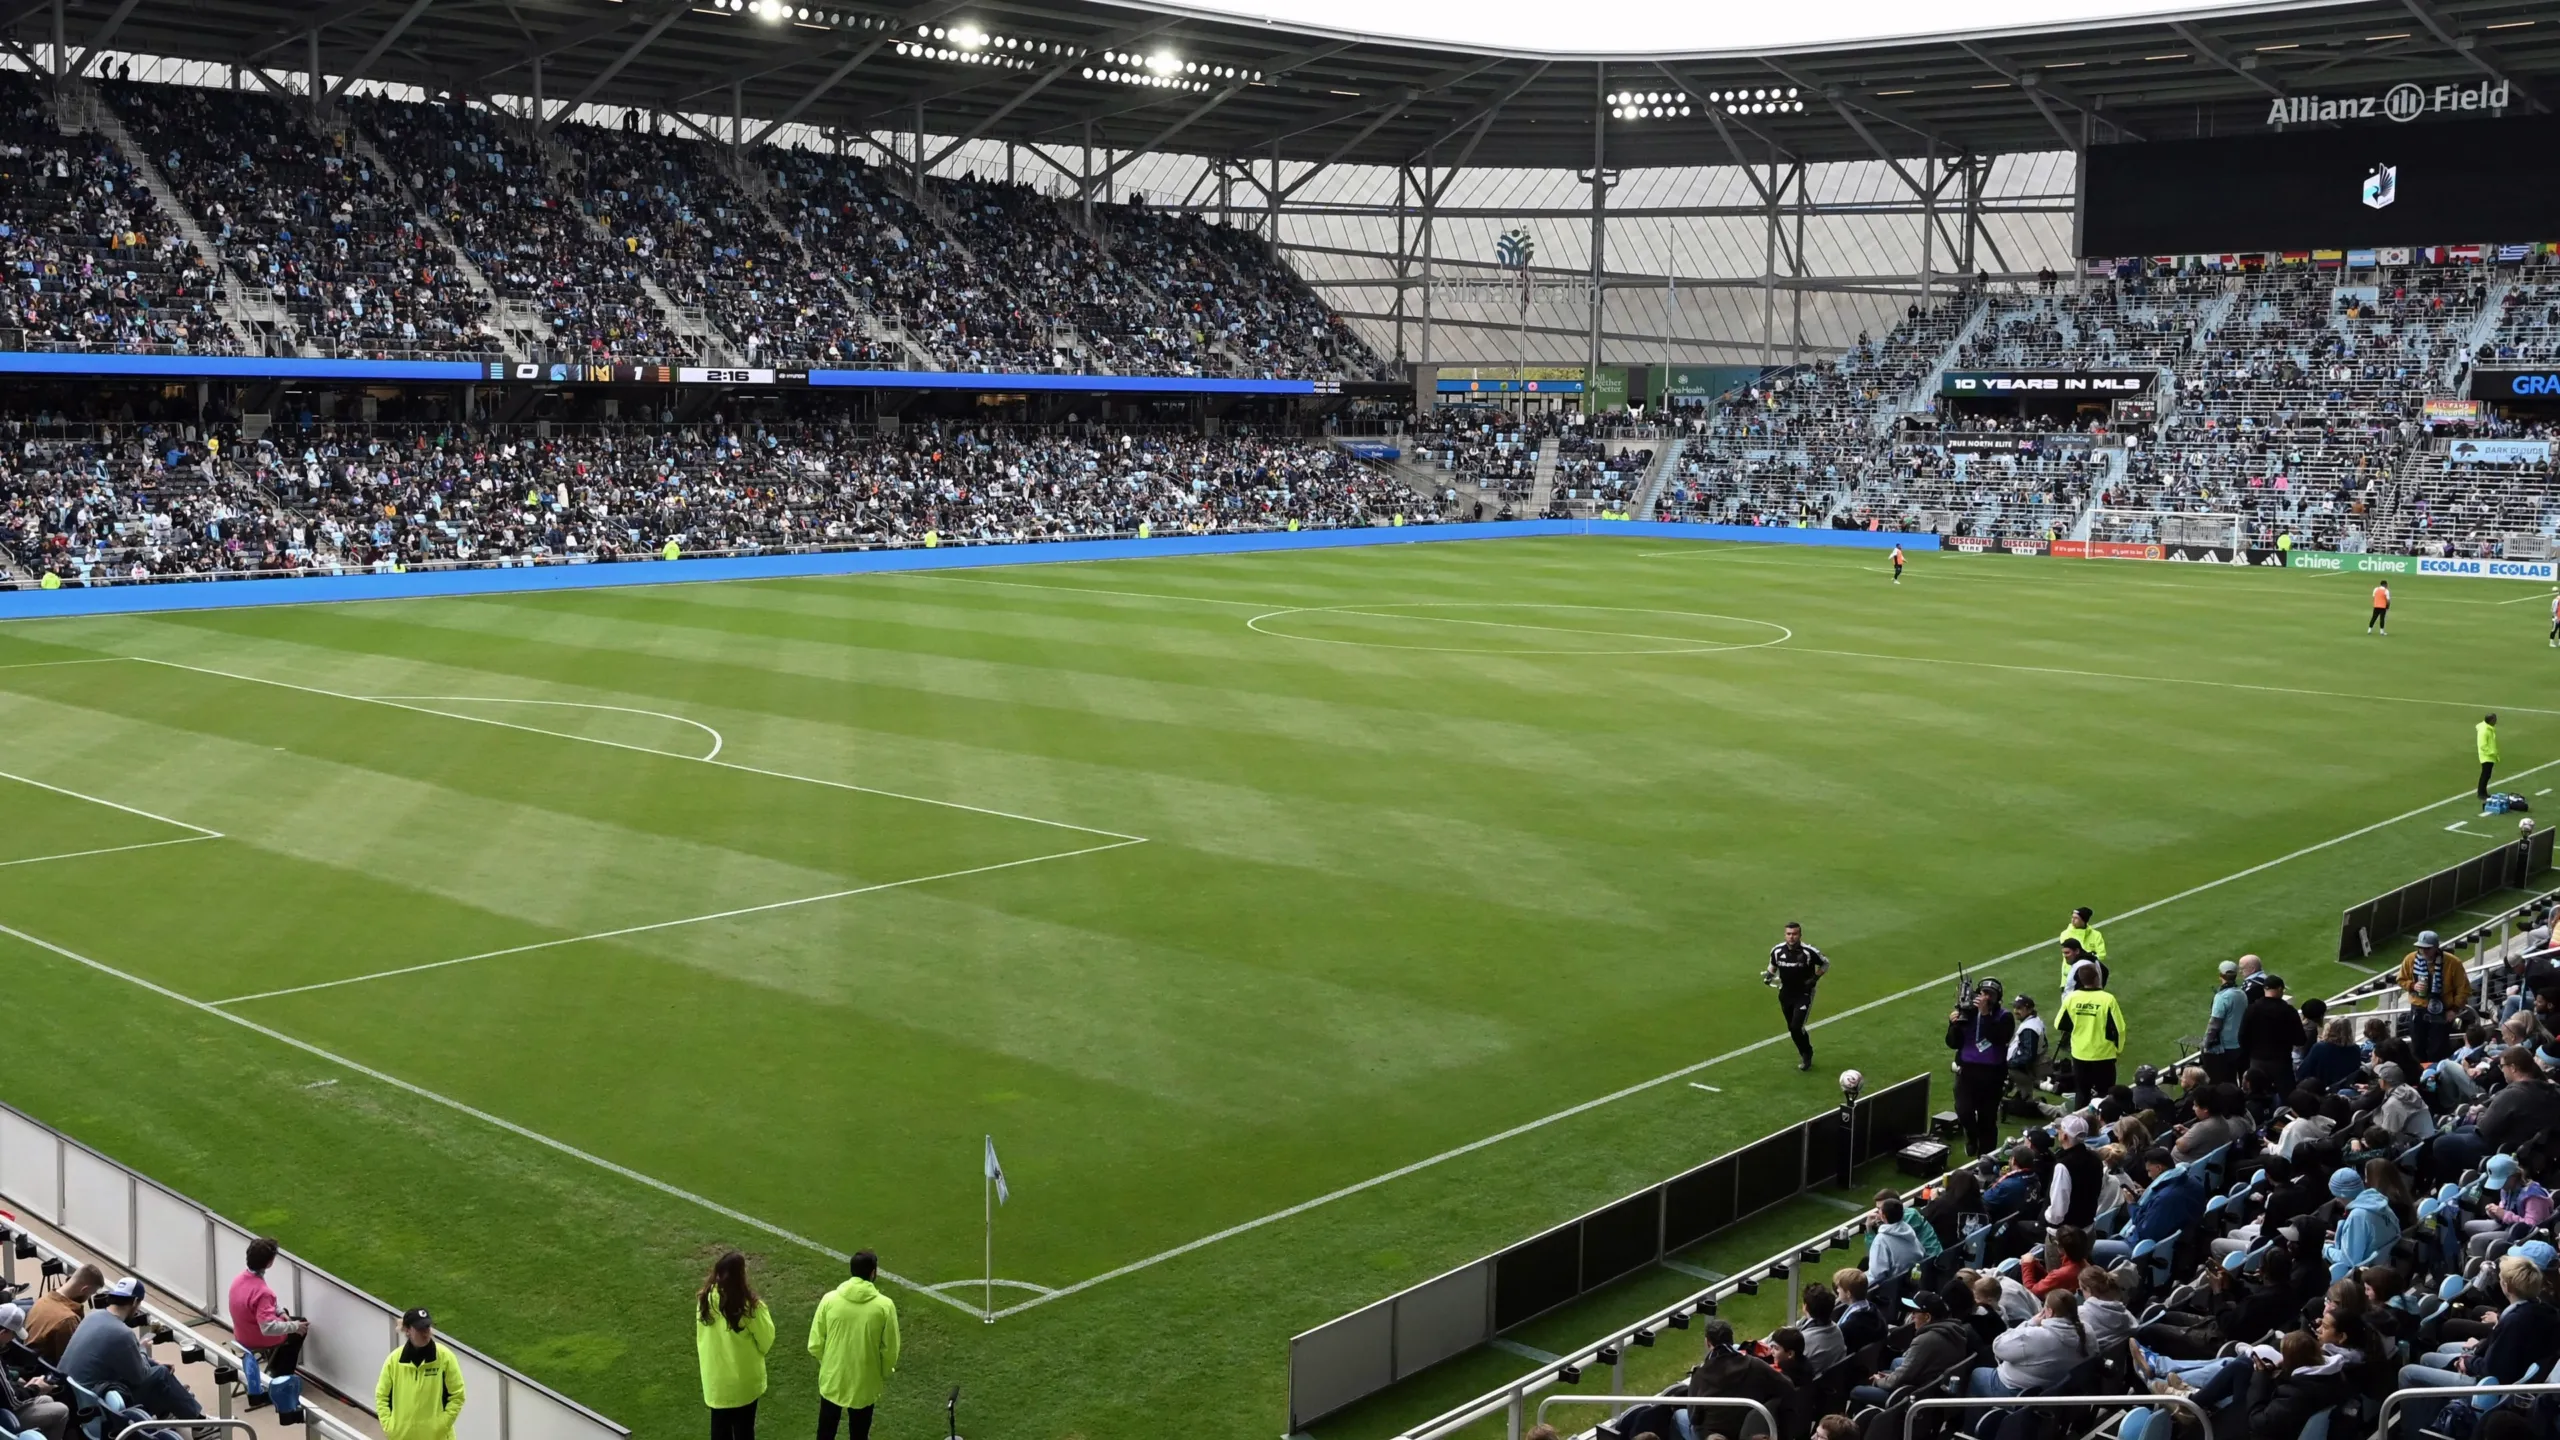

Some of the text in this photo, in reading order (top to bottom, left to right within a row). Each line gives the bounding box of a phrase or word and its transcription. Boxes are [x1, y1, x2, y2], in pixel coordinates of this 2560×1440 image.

[2267, 79, 2510, 124] Allianz Field
[1430, 276, 1598, 304] Allina Health
[516, 364, 539, 379] 0
[634, 366, 643, 381] 1
[707, 370, 749, 381] 2:16
[1589, 378, 1622, 388] tgether
[1954, 379, 2140, 389] 10 YEARS IN MLS
[1682, 385, 1706, 394] Health
[1948, 440, 1966, 448] TRUE
[1968, 440, 1993, 448] NORTH
[2051, 435, 2090, 443] #SaveTheCup
[1949, 536, 1993, 547] DISCOUNT
[2002, 539, 2048, 550] DISCOUNT
[2295, 554, 2405, 572] chime chime
[2421, 561, 2551, 577] ECOLAB ECOLAB
